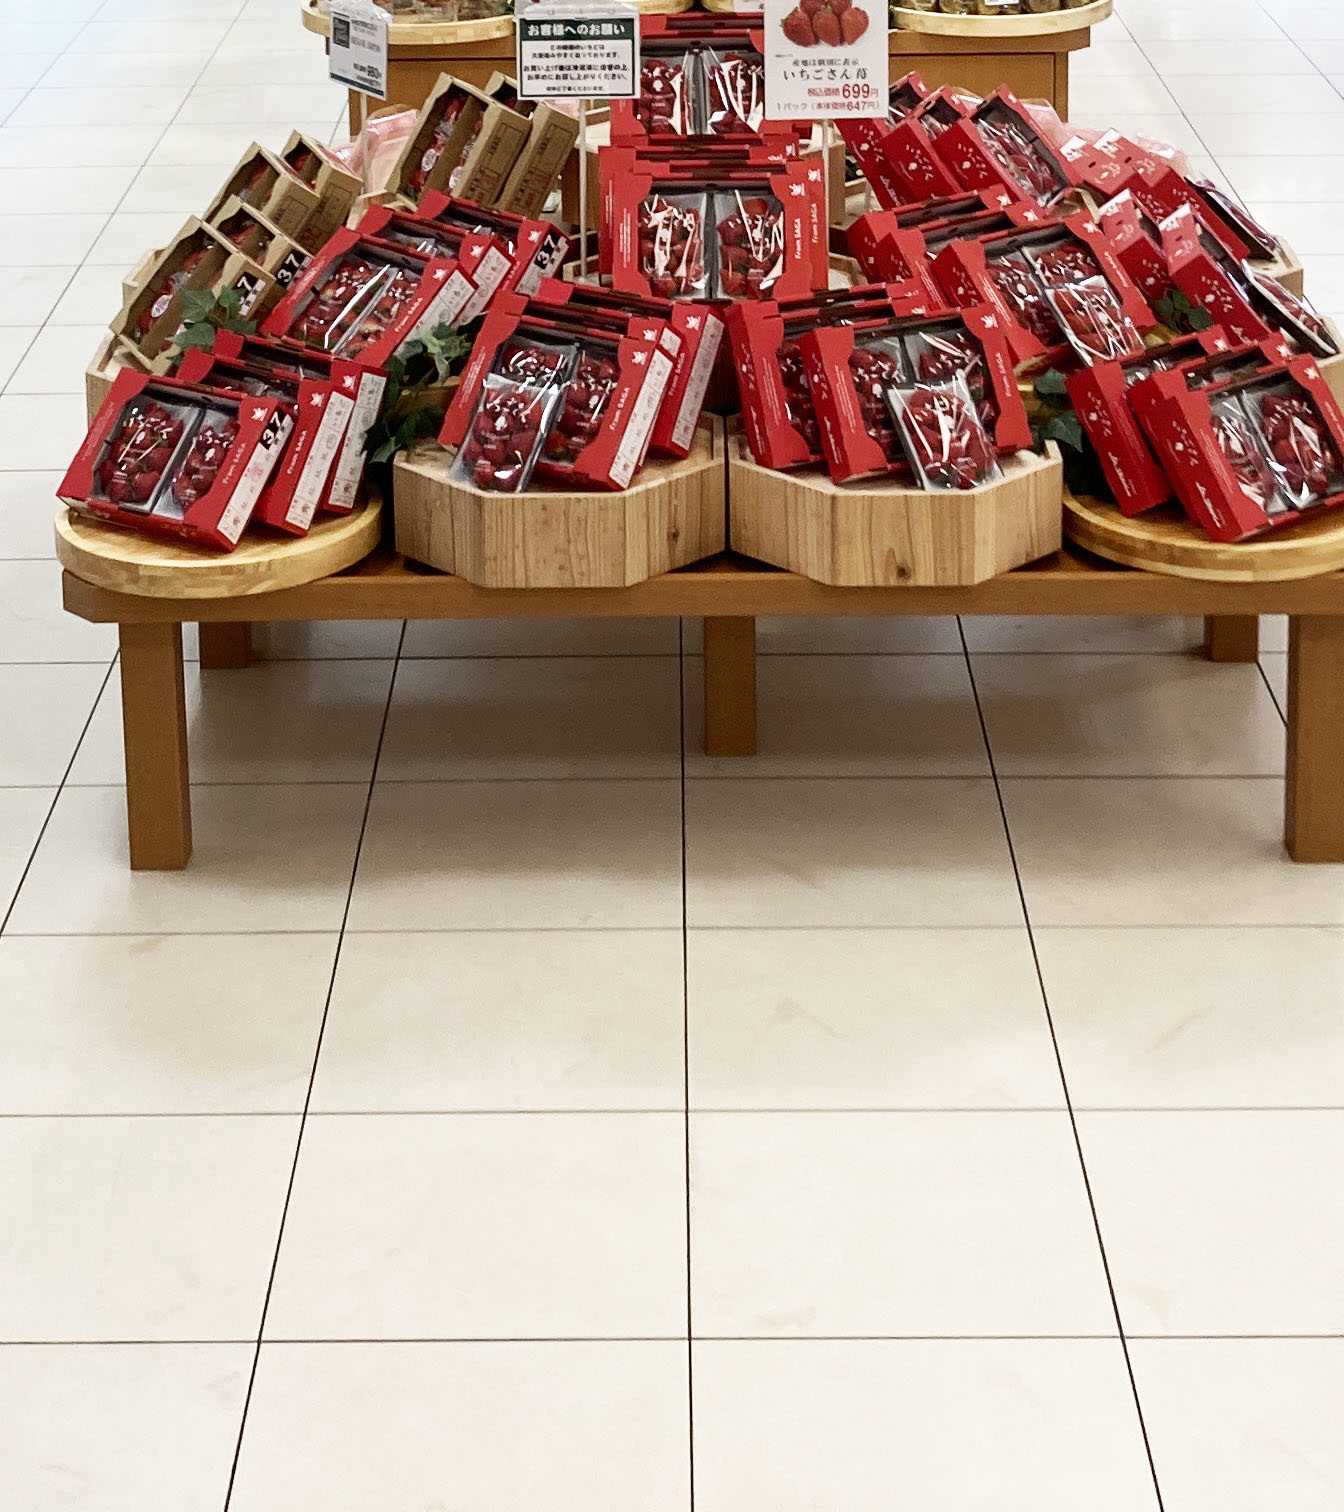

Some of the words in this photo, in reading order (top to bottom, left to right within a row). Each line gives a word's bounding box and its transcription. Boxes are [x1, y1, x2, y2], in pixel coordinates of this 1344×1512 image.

[527, 22, 626, 37] お客様へのお願い
[783, 68, 853, 81] いちごさん
[537, 233, 556, 266] 37
[276, 252, 301, 283] 37
[407, 297, 424, 316] SAGA
[616, 386, 631, 410] SAGA
[262, 410, 282, 445] 37
[294, 429, 309, 454] SAGA
[231, 442, 247, 467] SAGA
